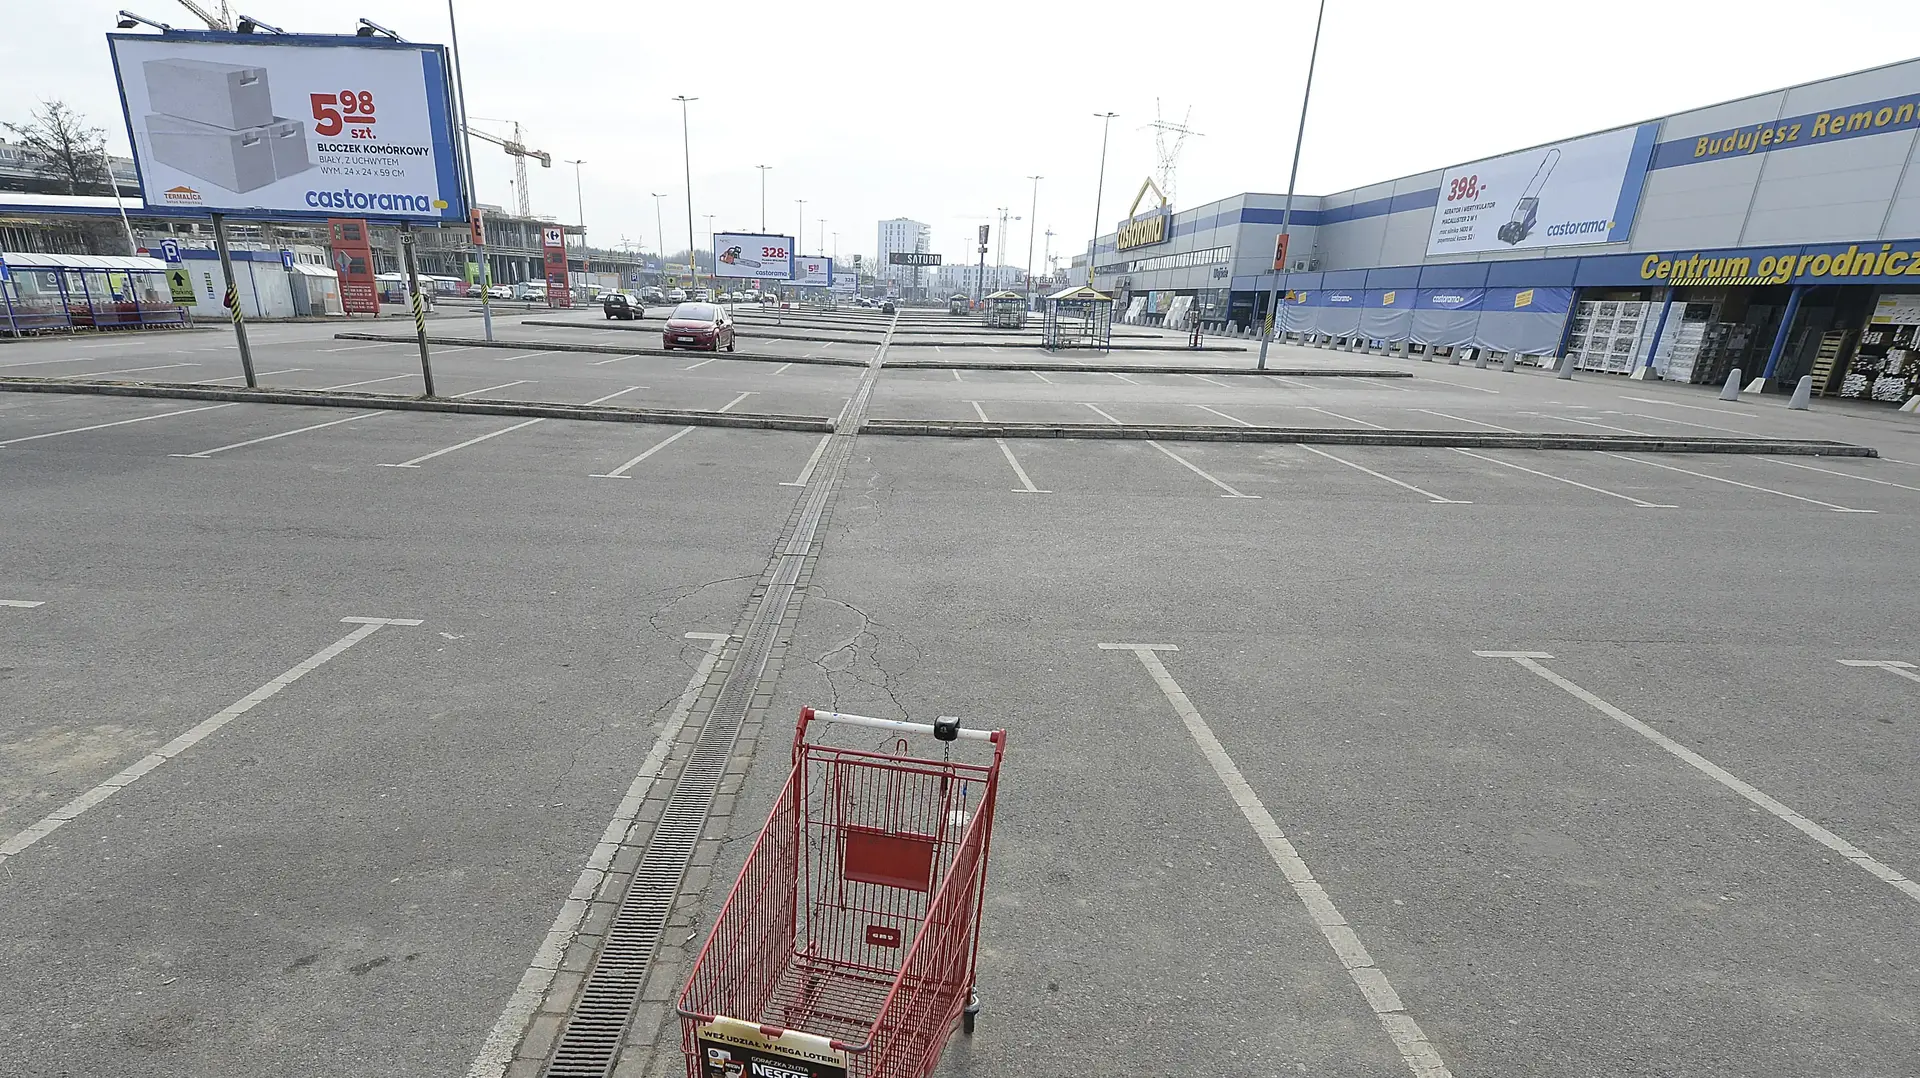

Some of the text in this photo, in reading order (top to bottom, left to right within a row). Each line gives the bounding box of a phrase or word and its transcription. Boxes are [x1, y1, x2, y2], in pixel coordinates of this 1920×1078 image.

[351, 127, 377, 139] szt.
[1694, 123, 1802, 158] Budujesz
[317, 143, 429, 156] BLOCZEK KOMÓRKOWY
[351, 157, 399, 166] UCHWYTEM
[344, 167, 354, 175] 24
[362, 168, 372, 176] 24
[380, 169, 390, 177] 59
[305, 189, 430, 212] castorama
[1117, 214, 1164, 250] castorama
[1547, 219, 1607, 236] castorama
[907, 254, 941, 265] SATURN
[1276, 243, 1283, 261] 6
[755, 269, 787, 277] castorama
[1640, 252, 1749, 279] Centrum
[172, 288, 194, 296] Parking
[703, 1030, 725, 1040] WEŹ
[726, 1036, 760, 1048] UDZIAŁ
[774, 1046, 801, 1056] MEGA
[803, 1051, 840, 1064] LOTERII
